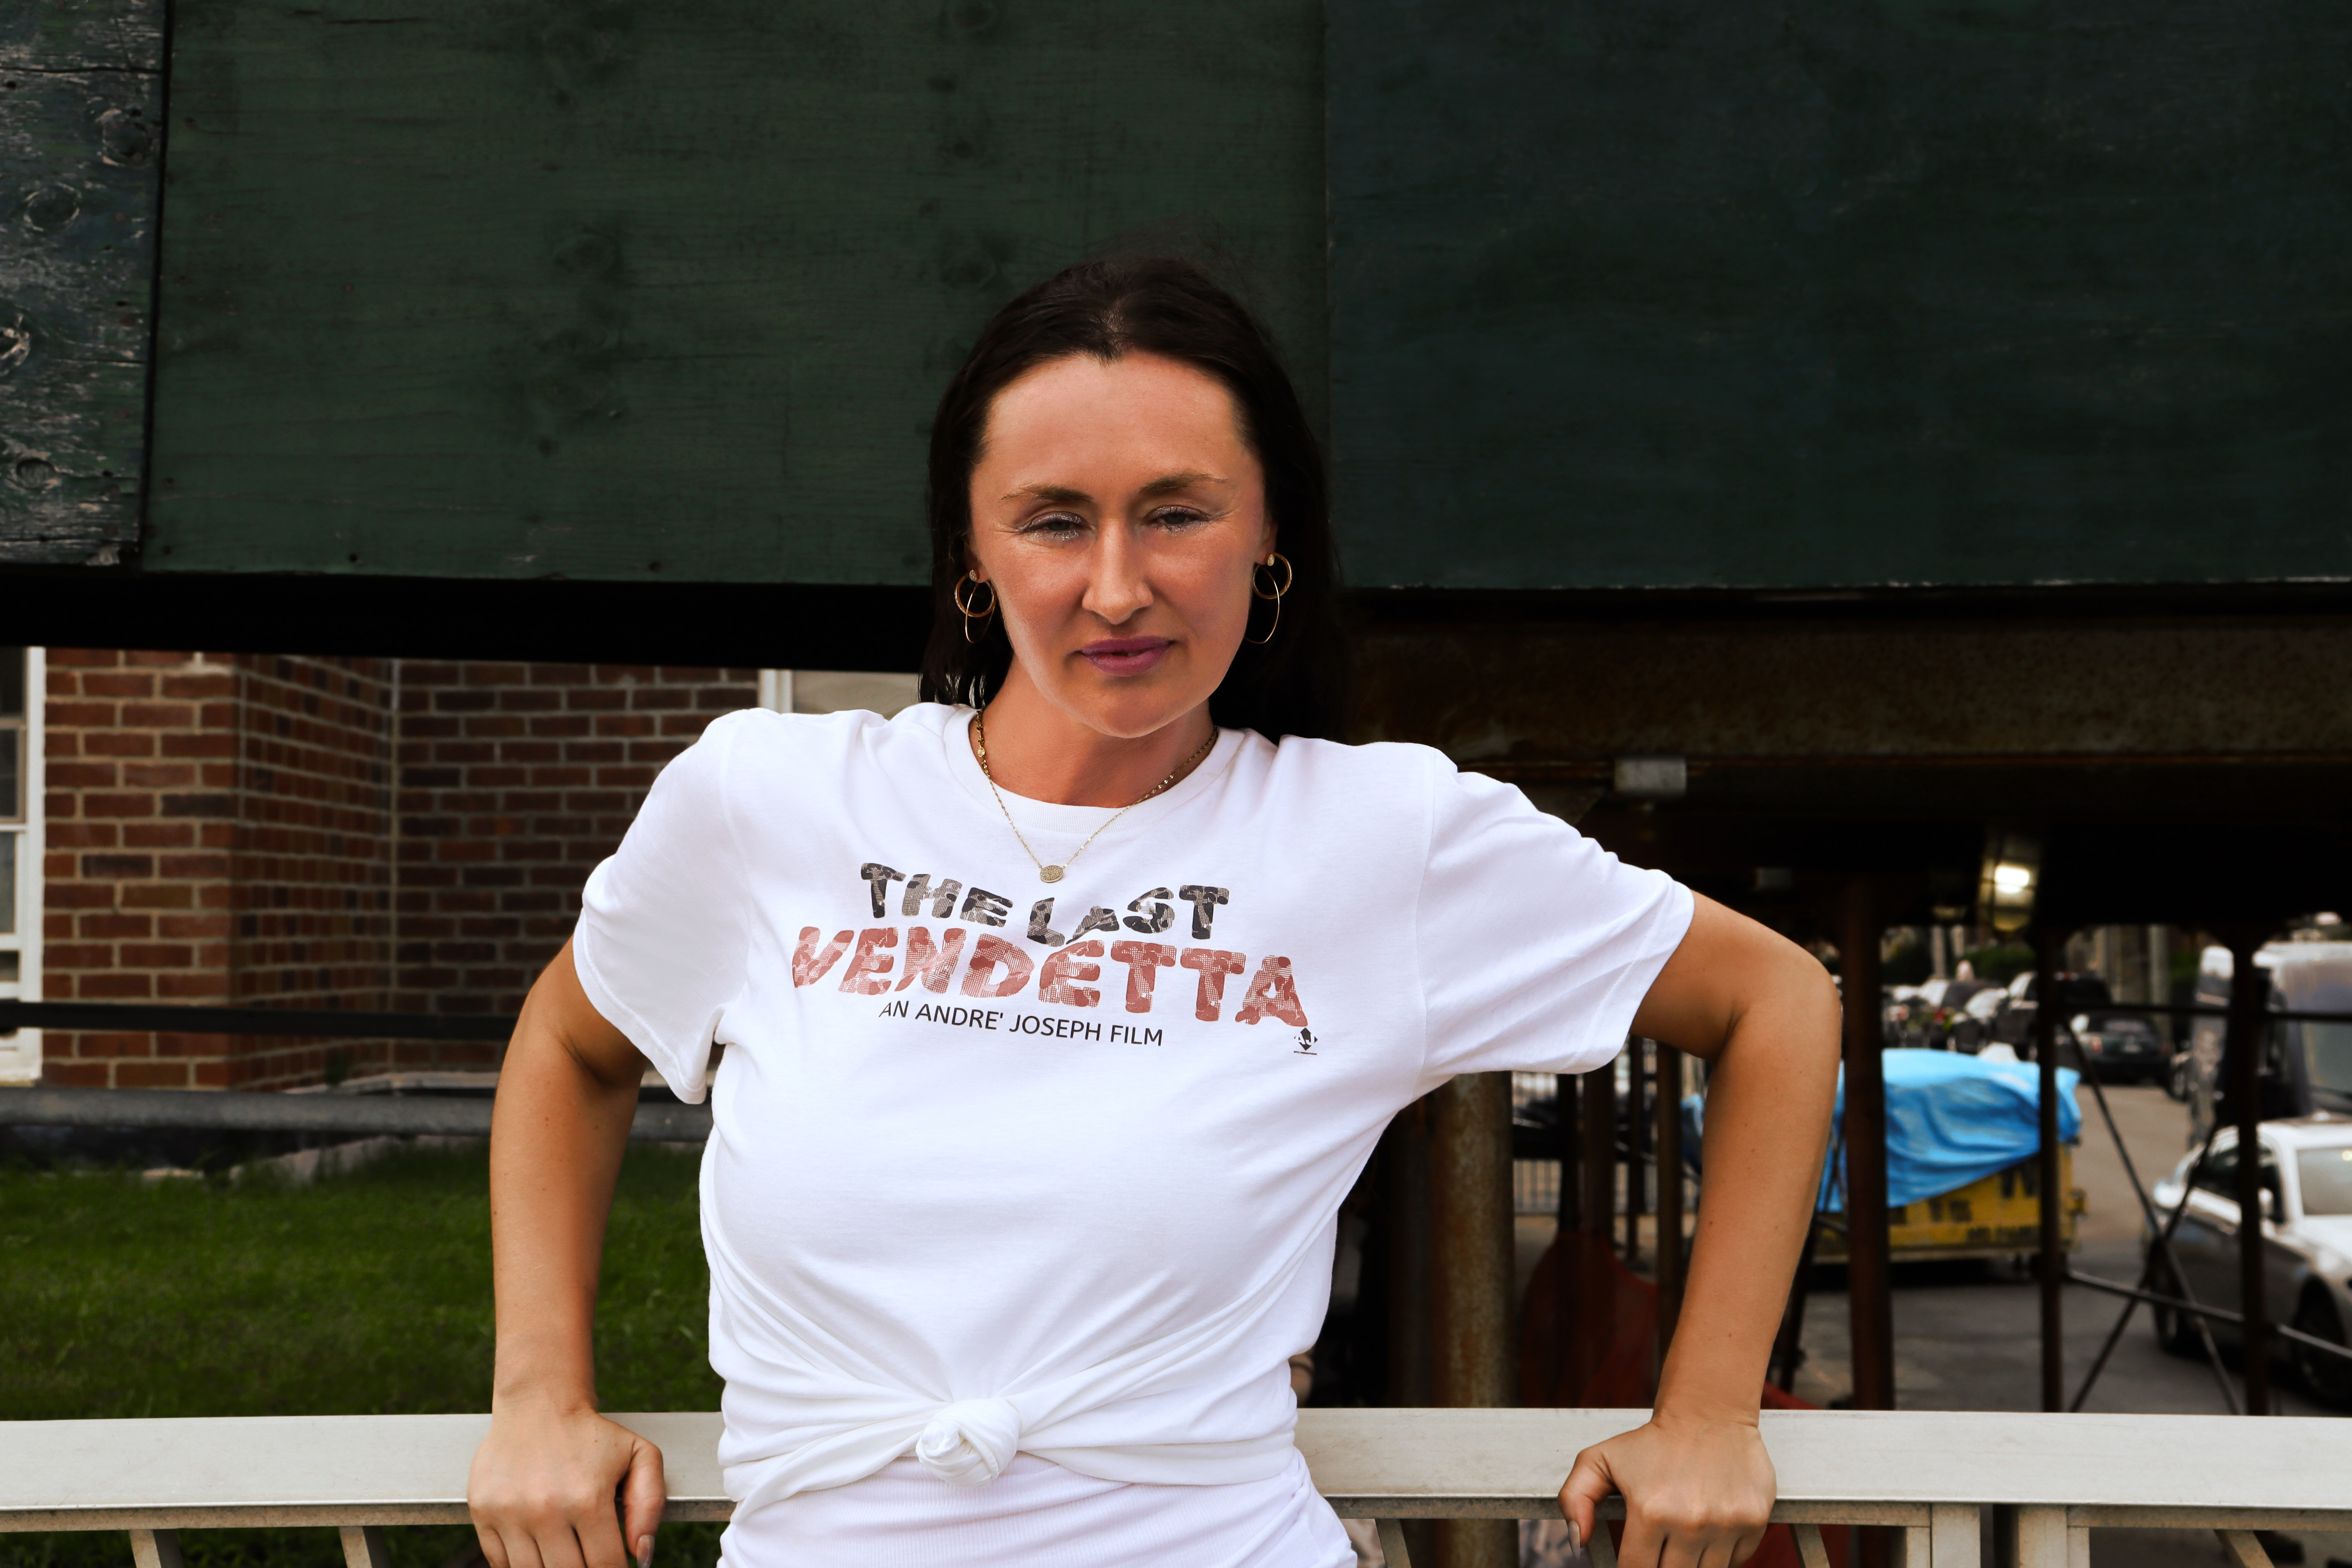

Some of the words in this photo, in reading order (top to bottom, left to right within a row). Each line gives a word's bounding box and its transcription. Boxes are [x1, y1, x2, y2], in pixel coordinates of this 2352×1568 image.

[860, 862, 1013, 928] THE
[1026, 885, 1230, 947] LAST
[791, 926, 1308, 1027] VENDETTA
[878, 1000, 909, 1018] AN
[915, 1004, 1004, 1030] ANDRE'
[1009, 1014, 1102, 1041] JOSEPH
[1110, 1025, 1163, 1046] FILM
[1293, 1031, 1315, 1046] AJ
